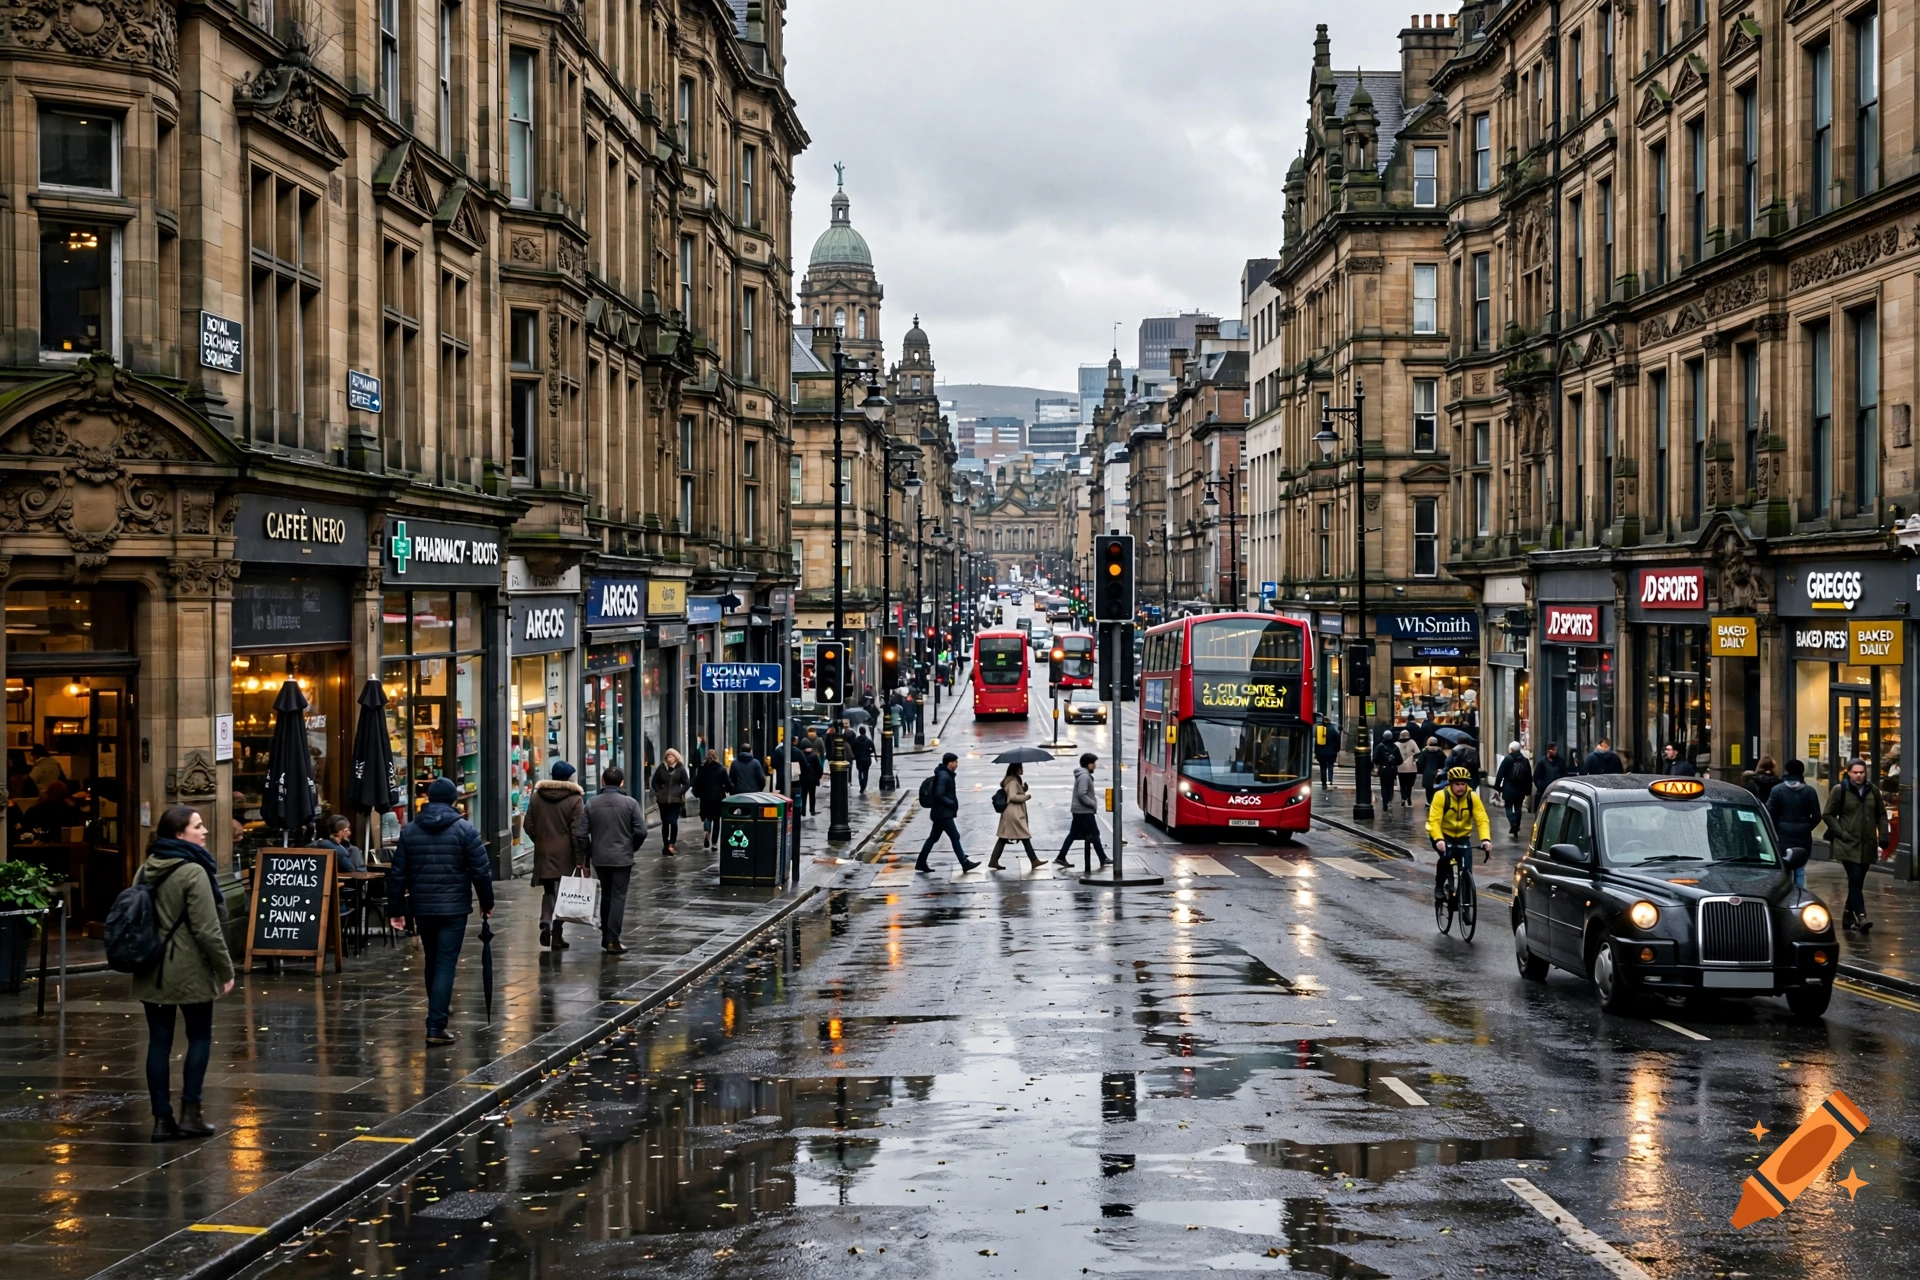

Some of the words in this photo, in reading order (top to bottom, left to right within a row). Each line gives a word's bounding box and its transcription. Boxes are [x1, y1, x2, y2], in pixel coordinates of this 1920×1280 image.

[266, 508, 308, 541] CAFFÈ
[312, 517, 346, 544] NERO
[472, 541, 499, 565] BOOTS
[1641, 575, 1657, 602] JD
[1658, 575, 1698, 602] SPORTS
[1806, 571, 1862, 601] GREGGS
[601, 585, 638, 617] ARGOS
[526, 608, 565, 639] ARGOS
[1396, 616, 1472, 633] WhSmith
[1560, 613, 1593, 637] SPORTS
[1718, 625, 1749, 637] BAKED
[1858, 629, 1894, 642] BAKED
[1720, 637, 1746, 649] DAILY
[1796, 630, 1823, 648] BAKED
[1860, 643, 1890, 655] DAILY
[1203, 683, 1210, 695] 2
[1664, 783, 1693, 793] TAXI
[1228, 795, 1261, 805] ARGOS
[270, 858, 317, 871] TODAY'S
[266, 873, 318, 887] SPECIALS
[270, 895, 300, 907] SOUP
[269, 910, 306, 923] PANINI
[264, 927, 299, 939] LATTE
